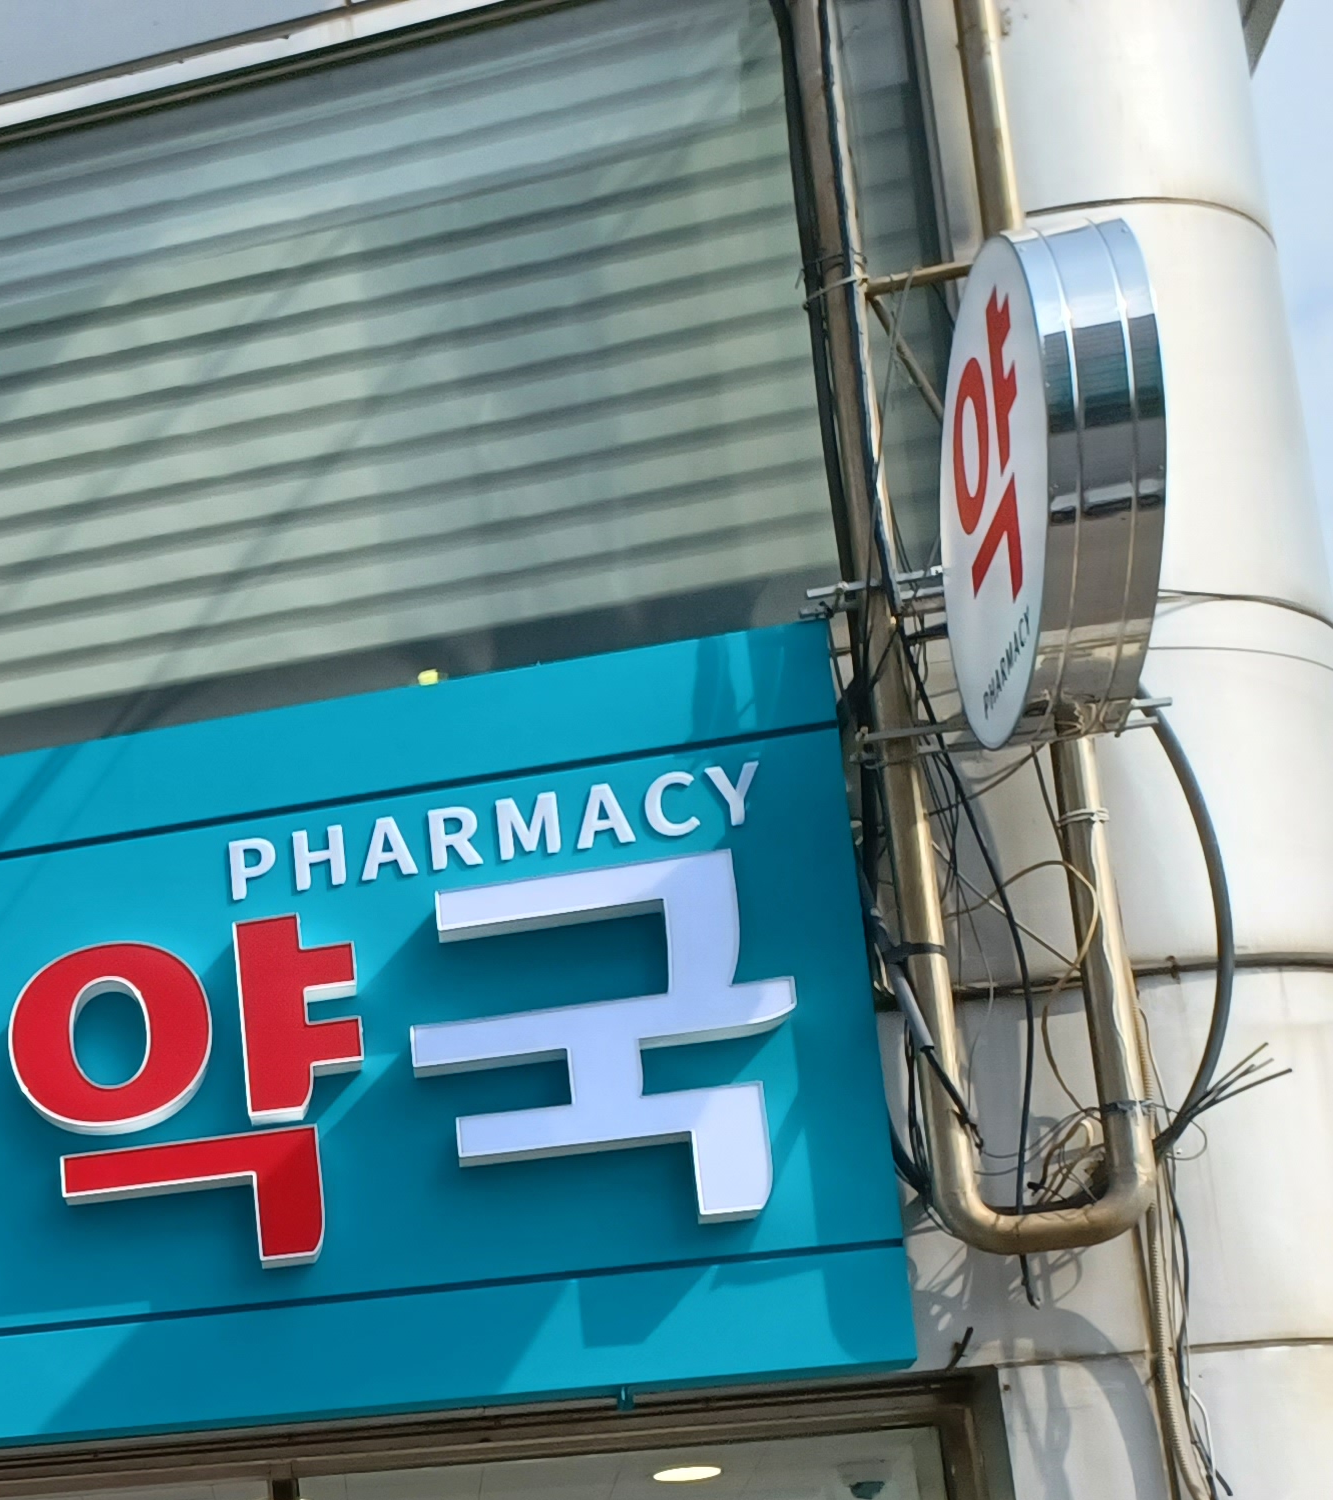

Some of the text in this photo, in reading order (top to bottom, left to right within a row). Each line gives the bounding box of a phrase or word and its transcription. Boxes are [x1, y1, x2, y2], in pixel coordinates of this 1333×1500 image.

[952, 284, 1023, 602] 약
[982, 605, 1032, 719] PHARMACY
[228, 759, 761, 902] PHARMACY
